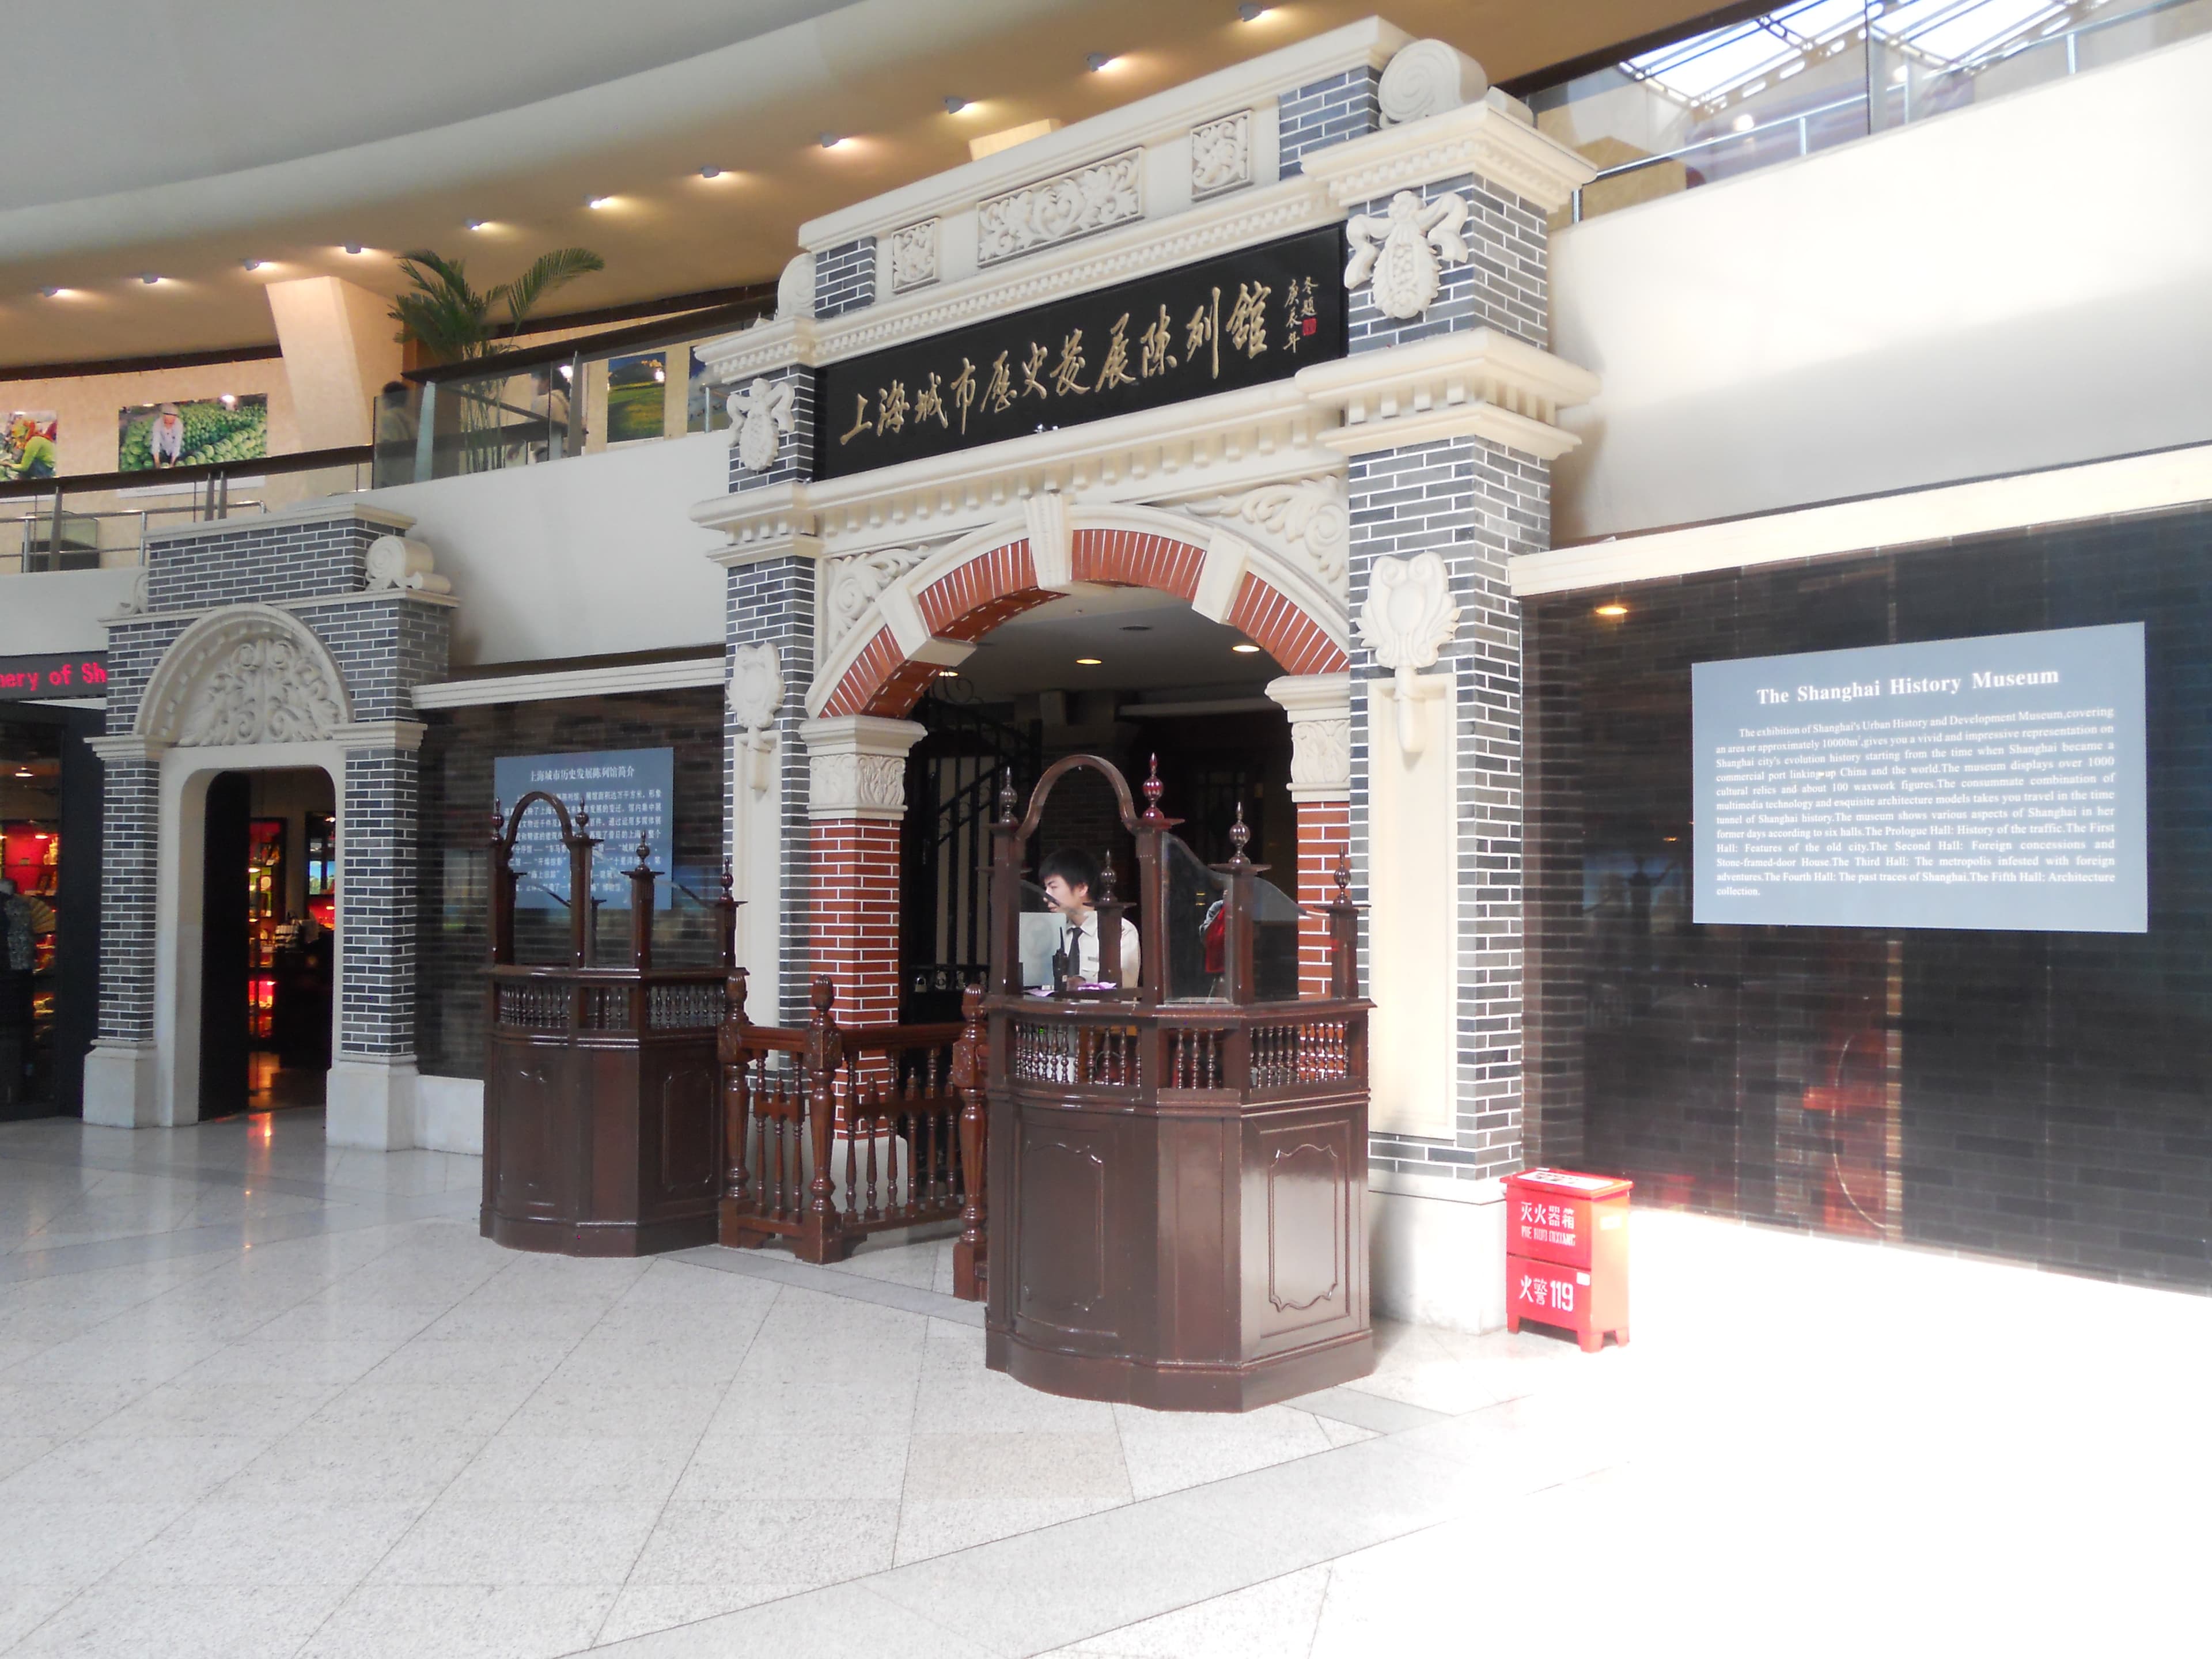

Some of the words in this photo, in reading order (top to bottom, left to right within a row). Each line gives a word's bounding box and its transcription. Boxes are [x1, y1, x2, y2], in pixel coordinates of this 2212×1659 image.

[48, 664, 73, 686] of
[81, 662, 107, 684] Sh
[1756, 688, 1788, 704] The
[1797, 680, 1880, 702] Shanghai
[1890, 676, 1960, 695] History
[1972, 671, 2058, 689] Museum
[1739, 728, 1755, 738] The
[1756, 726, 1800, 737] exhibition
[1801, 724, 1812, 734] of
[1812, 721, 1860, 734] Shanghai's
[1862, 720, 1890, 730] Urban
[1892, 718, 1927, 729] History
[1930, 715, 1947, 726] and
[1949, 711, 2016, 726] Development
[1728, 745, 1745, 753] area
[1758, 738, 1819, 753] approximately
[1890, 736, 1907, 747] you
[1918, 732, 1942, 743] vivid
[1945, 730, 1963, 741] and
[1965, 728, 2018, 742] impressive
[2022, 724, 2097, 739] representation
[2100, 725, 2113, 733] on
[1716, 756, 1754, 769] Shanghai
[1758, 755, 1780, 767] city's
[1785, 753, 1825, 764] evolution
[1829, 752, 1860, 763] history
[1865, 749, 1900, 762] starting
[1904, 749, 1926, 759] from
[1931, 747, 1946, 757] the
[1951, 746, 1972, 757] time
[1978, 744, 2003, 755] when
[2009, 741, 2056, 755] Shanghai
[2062, 741, 2102, 752] became
[2108, 741, 2114, 749] a
[1716, 771, 1765, 782] commercial
[1768, 770, 1785, 782] port
[1839, 767, 1866, 777] China
[1871, 765, 1887, 775] and
[1892, 764, 1906, 775] the
[1964, 763, 2006, 772] museum
[2010, 759, 2053, 772] displays
[2058, 759, 2081, 768] over
[2089, 755, 2115, 767] 1000
[1716, 786, 1748, 796] cultural
[1753, 785, 1776, 795] relics
[1781, 783, 1797, 794] and
[1802, 782, 1826, 793] about
[1833, 782, 1848, 792] 100
[1854, 780, 1895, 791] waxwork
[1961, 775, 2023, 787] consummate
[2030, 772, 2096, 785] combination
[2103, 771, 2115, 783] of
[1717, 800, 1763, 810] multimedia
[1765, 798, 1812, 810] technology
[1815, 797, 1831, 807] and
[1878, 794, 1933, 805] architecture
[1936, 793, 1970, 804] models
[1973, 792, 1998, 803] takes
[2002, 794, 2020, 804] you
[2024, 790, 2054, 801] travel
[2057, 790, 2067, 801] in
[2070, 789, 2086, 800] the
[2090, 789, 2115, 800] time
[1717, 814, 1742, 824] tunnel
[1746, 814, 1755, 824] of
[1758, 813, 1797, 825] Shanghai
[1855, 813, 1893, 821] museum
[1898, 810, 1926, 820] shows
[1932, 809, 1966, 819] various
[1971, 808, 2008, 821] aspects
[2012, 807, 2023, 817] of
[2028, 805, 2076, 819] Shanghai
[2082, 805, 2092, 816] in
[2097, 805, 2115, 816] her
[1717, 829, 1744, 838] former
[1747, 828, 1766, 840] days
[1768, 828, 1810, 839] according
[1813, 827, 1821, 837] to
[1824, 827, 1837, 836] six
[1885, 825, 1927, 838] Prologue
[1929, 824, 1953, 835] Hall:
[1957, 824, 1993, 836] History
[1997, 823, 2008, 834] of
[2010, 823, 2026, 834] the
[2089, 821, 2115, 832] First
[1717, 843, 1737, 853] Hall:
[1745, 843, 1781, 852] Features
[1789, 842, 1798, 852] of
[1805, 842, 1819, 851] the
[1827, 842, 1841, 851] old
[1895, 840, 1930, 851] Second
[1938, 840, 1962, 850] Hall:
[1971, 839, 2012, 852] Foreign
[2020, 839, 2085, 850] concessions
[2094, 838, 2115, 849] and
[1717, 857, 1795, 866] Stone-framed-door
[1855, 856, 1880, 866] Third
[1886, 856, 1908, 866] Hall:
[1915, 855, 1933, 866] The
[1939, 855, 1991, 868] metropolis
[1998, 855, 2039, 865] infested
[2046, 855, 2069, 865] with
[2075, 854, 2115, 868] foreign
[1783, 871, 1811, 881] Fourth
[1814, 871, 1835, 881] Hall:
[1839, 871, 1855, 881] The
[1858, 871, 1876, 883] past
[1879, 871, 1907, 881] traces
[1910, 871, 1919, 881] of
[1991, 871, 2016, 881] Fifth
[2018, 871, 2044, 881] Hall:
[2049, 871, 2115, 881] Architecture
[1521, 1201, 1575, 1229] 灭火器箱
